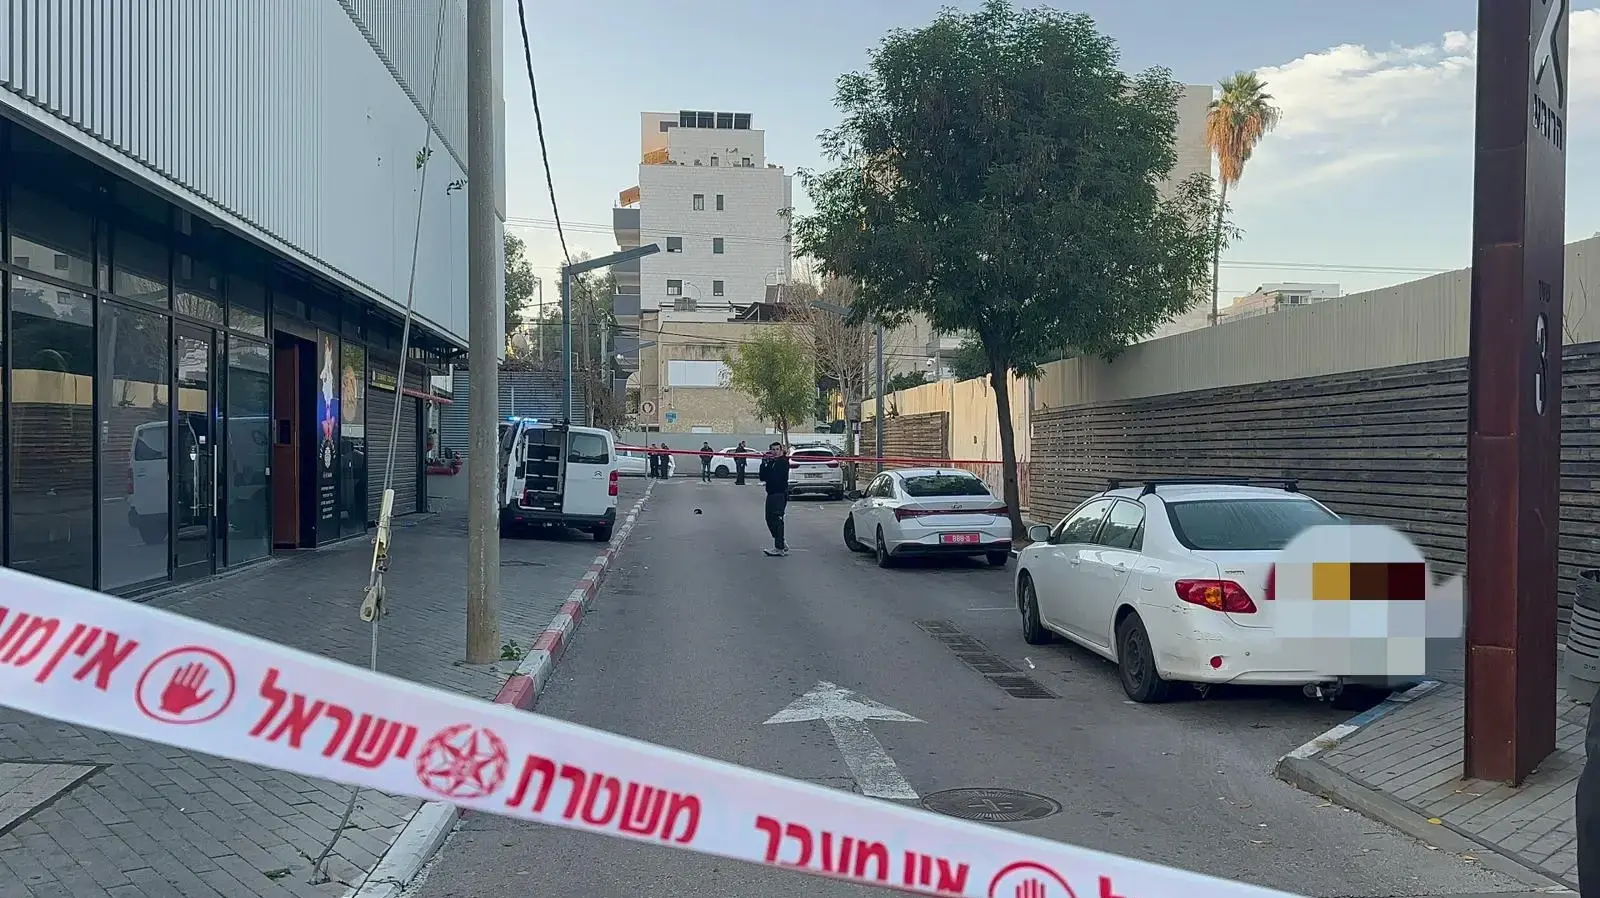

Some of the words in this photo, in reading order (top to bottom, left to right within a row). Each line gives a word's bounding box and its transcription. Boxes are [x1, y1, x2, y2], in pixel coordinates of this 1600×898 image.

[1535, 312, 1548, 416] 3
[35, 623, 140, 691] אין
[249, 667, 418, 769] ישראל
[505, 754, 702, 844] משטרת
